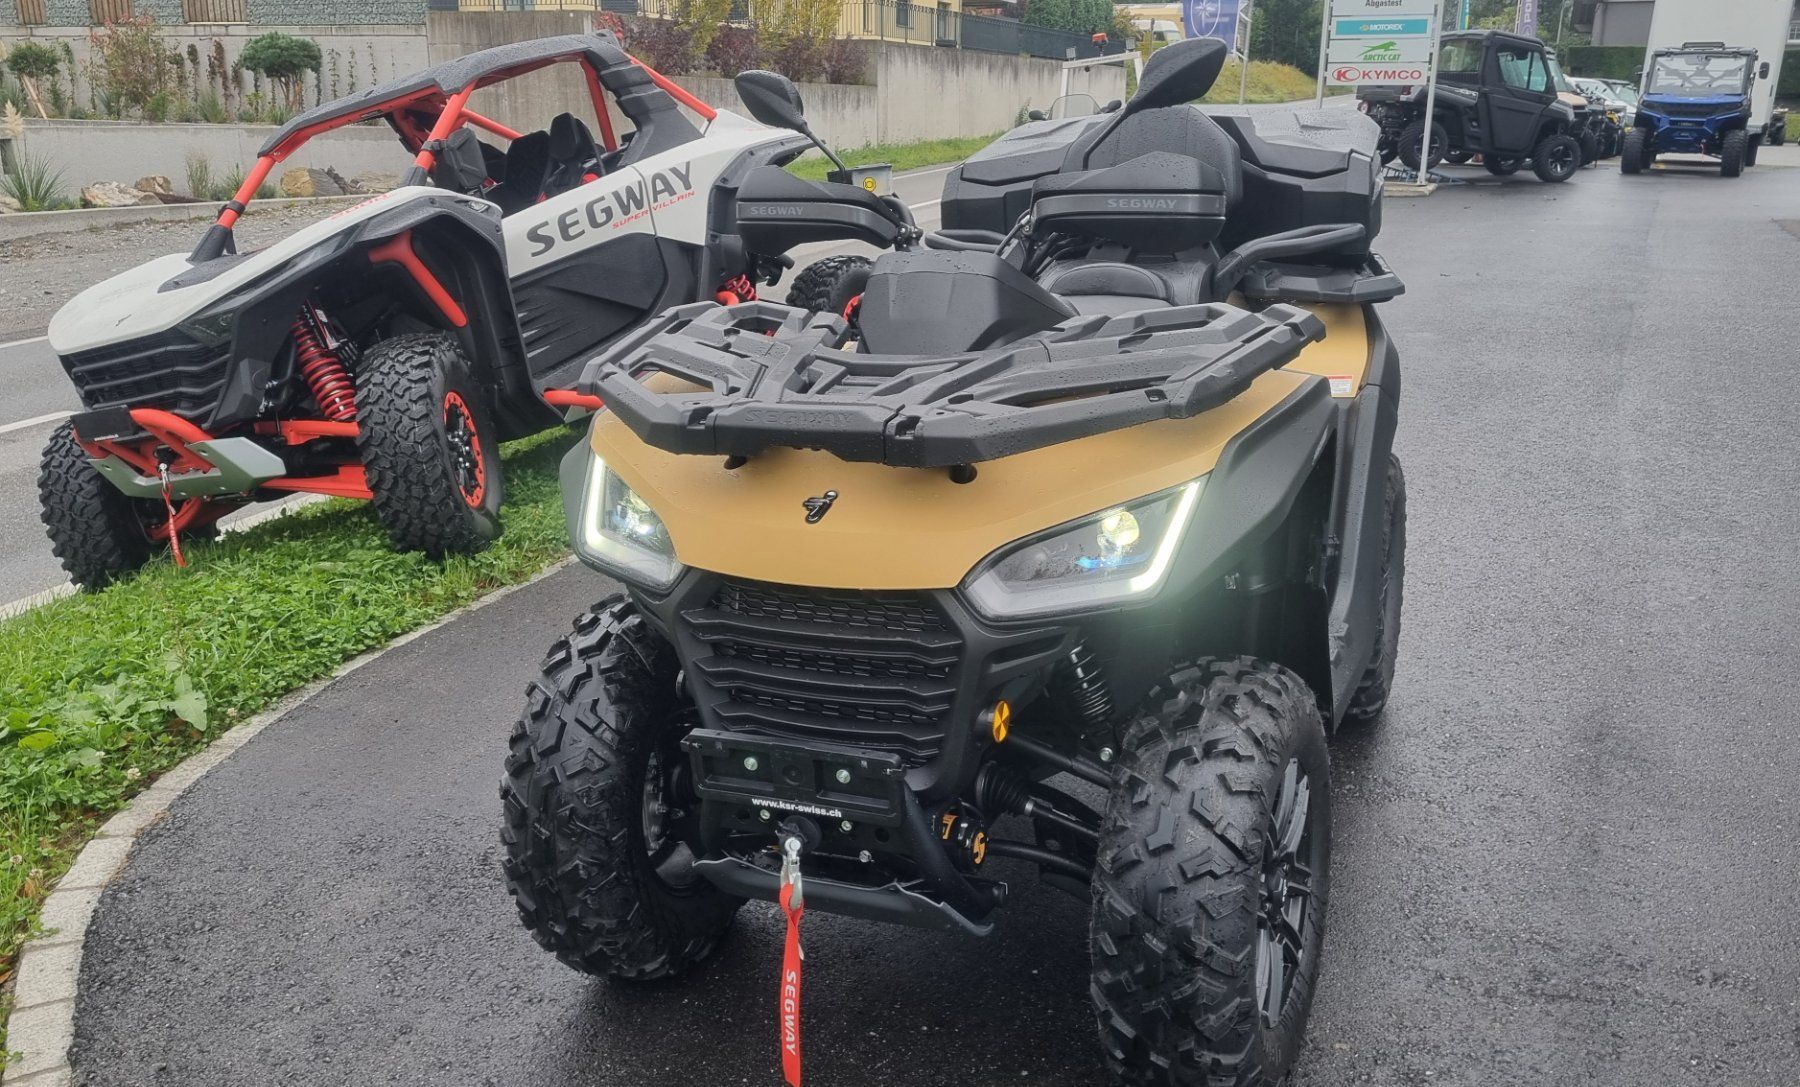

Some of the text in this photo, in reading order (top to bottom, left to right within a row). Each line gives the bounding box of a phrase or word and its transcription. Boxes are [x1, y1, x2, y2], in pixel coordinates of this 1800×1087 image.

[1369, 23, 1403, 31] MOTOREX
[1388, 53, 1401, 61] CAT
[1362, 69, 1422, 80] KYMCO
[526, 161, 693, 257] SEGWAY
[611, 190, 696, 230] SUPER VILLAIN
[750, 206, 804, 216] SEGWAY
[1107, 198, 1177, 209] SEGWAY
[745, 408, 857, 427] SEGWAY
[752, 798, 842, 818] www.ksr-swiss.ch
[784, 969, 797, 1056] SEGWAY
